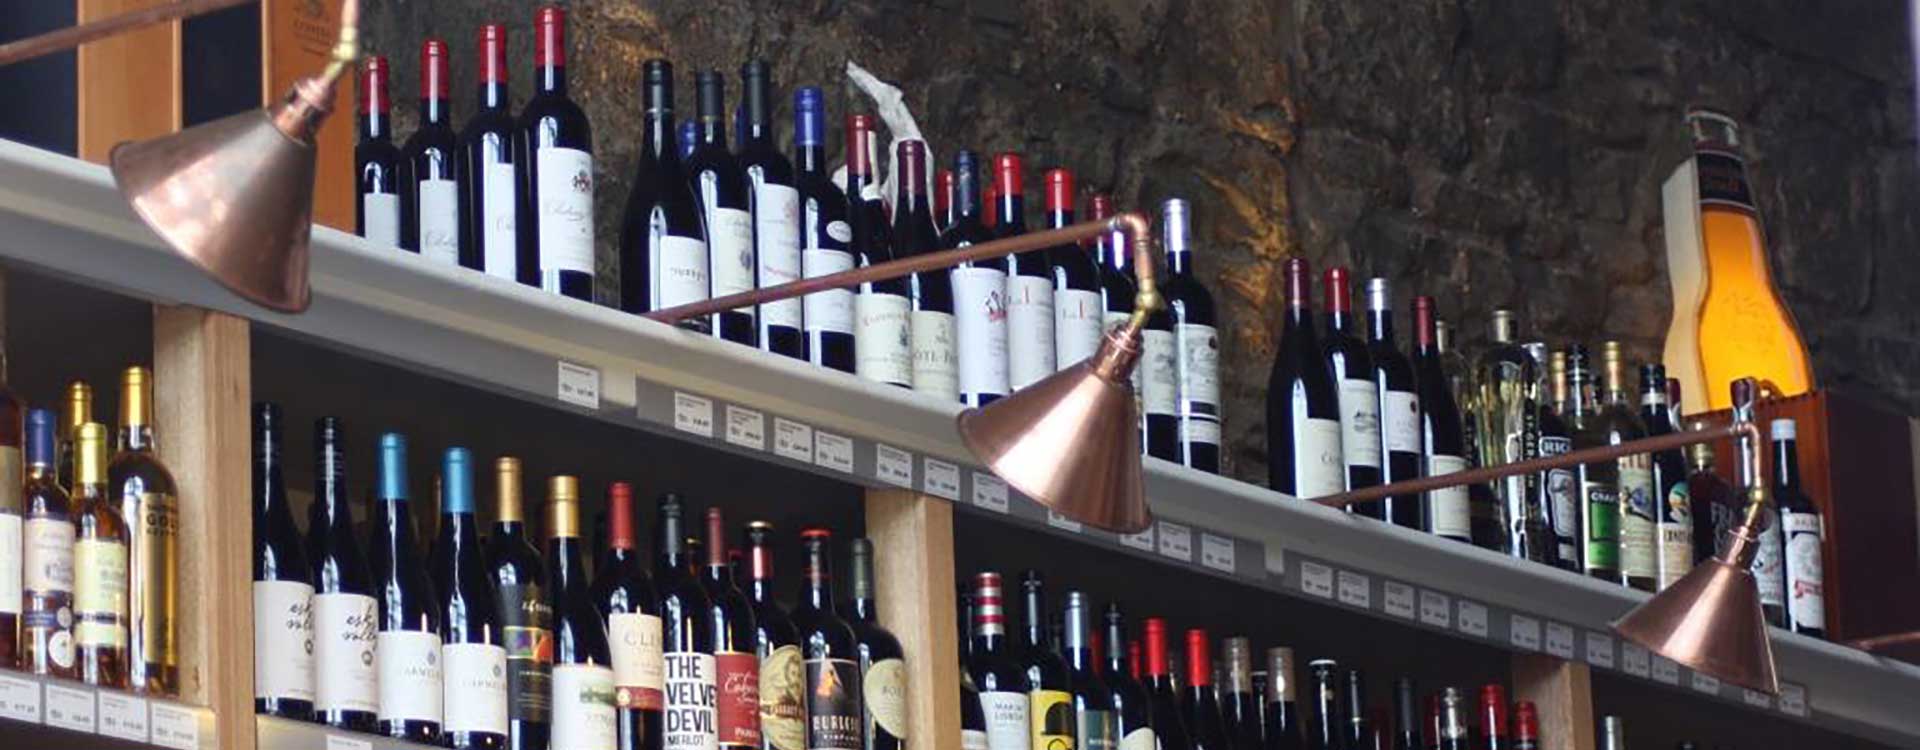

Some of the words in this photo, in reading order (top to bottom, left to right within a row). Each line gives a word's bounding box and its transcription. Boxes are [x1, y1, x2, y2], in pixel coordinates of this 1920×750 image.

[1543, 441, 1570, 454] RIC
[665, 656, 702, 678] THE
[666, 682, 718, 708] VELVE
[667, 709, 715, 734] DEVIL
[667, 735, 704, 746] MERLOT
